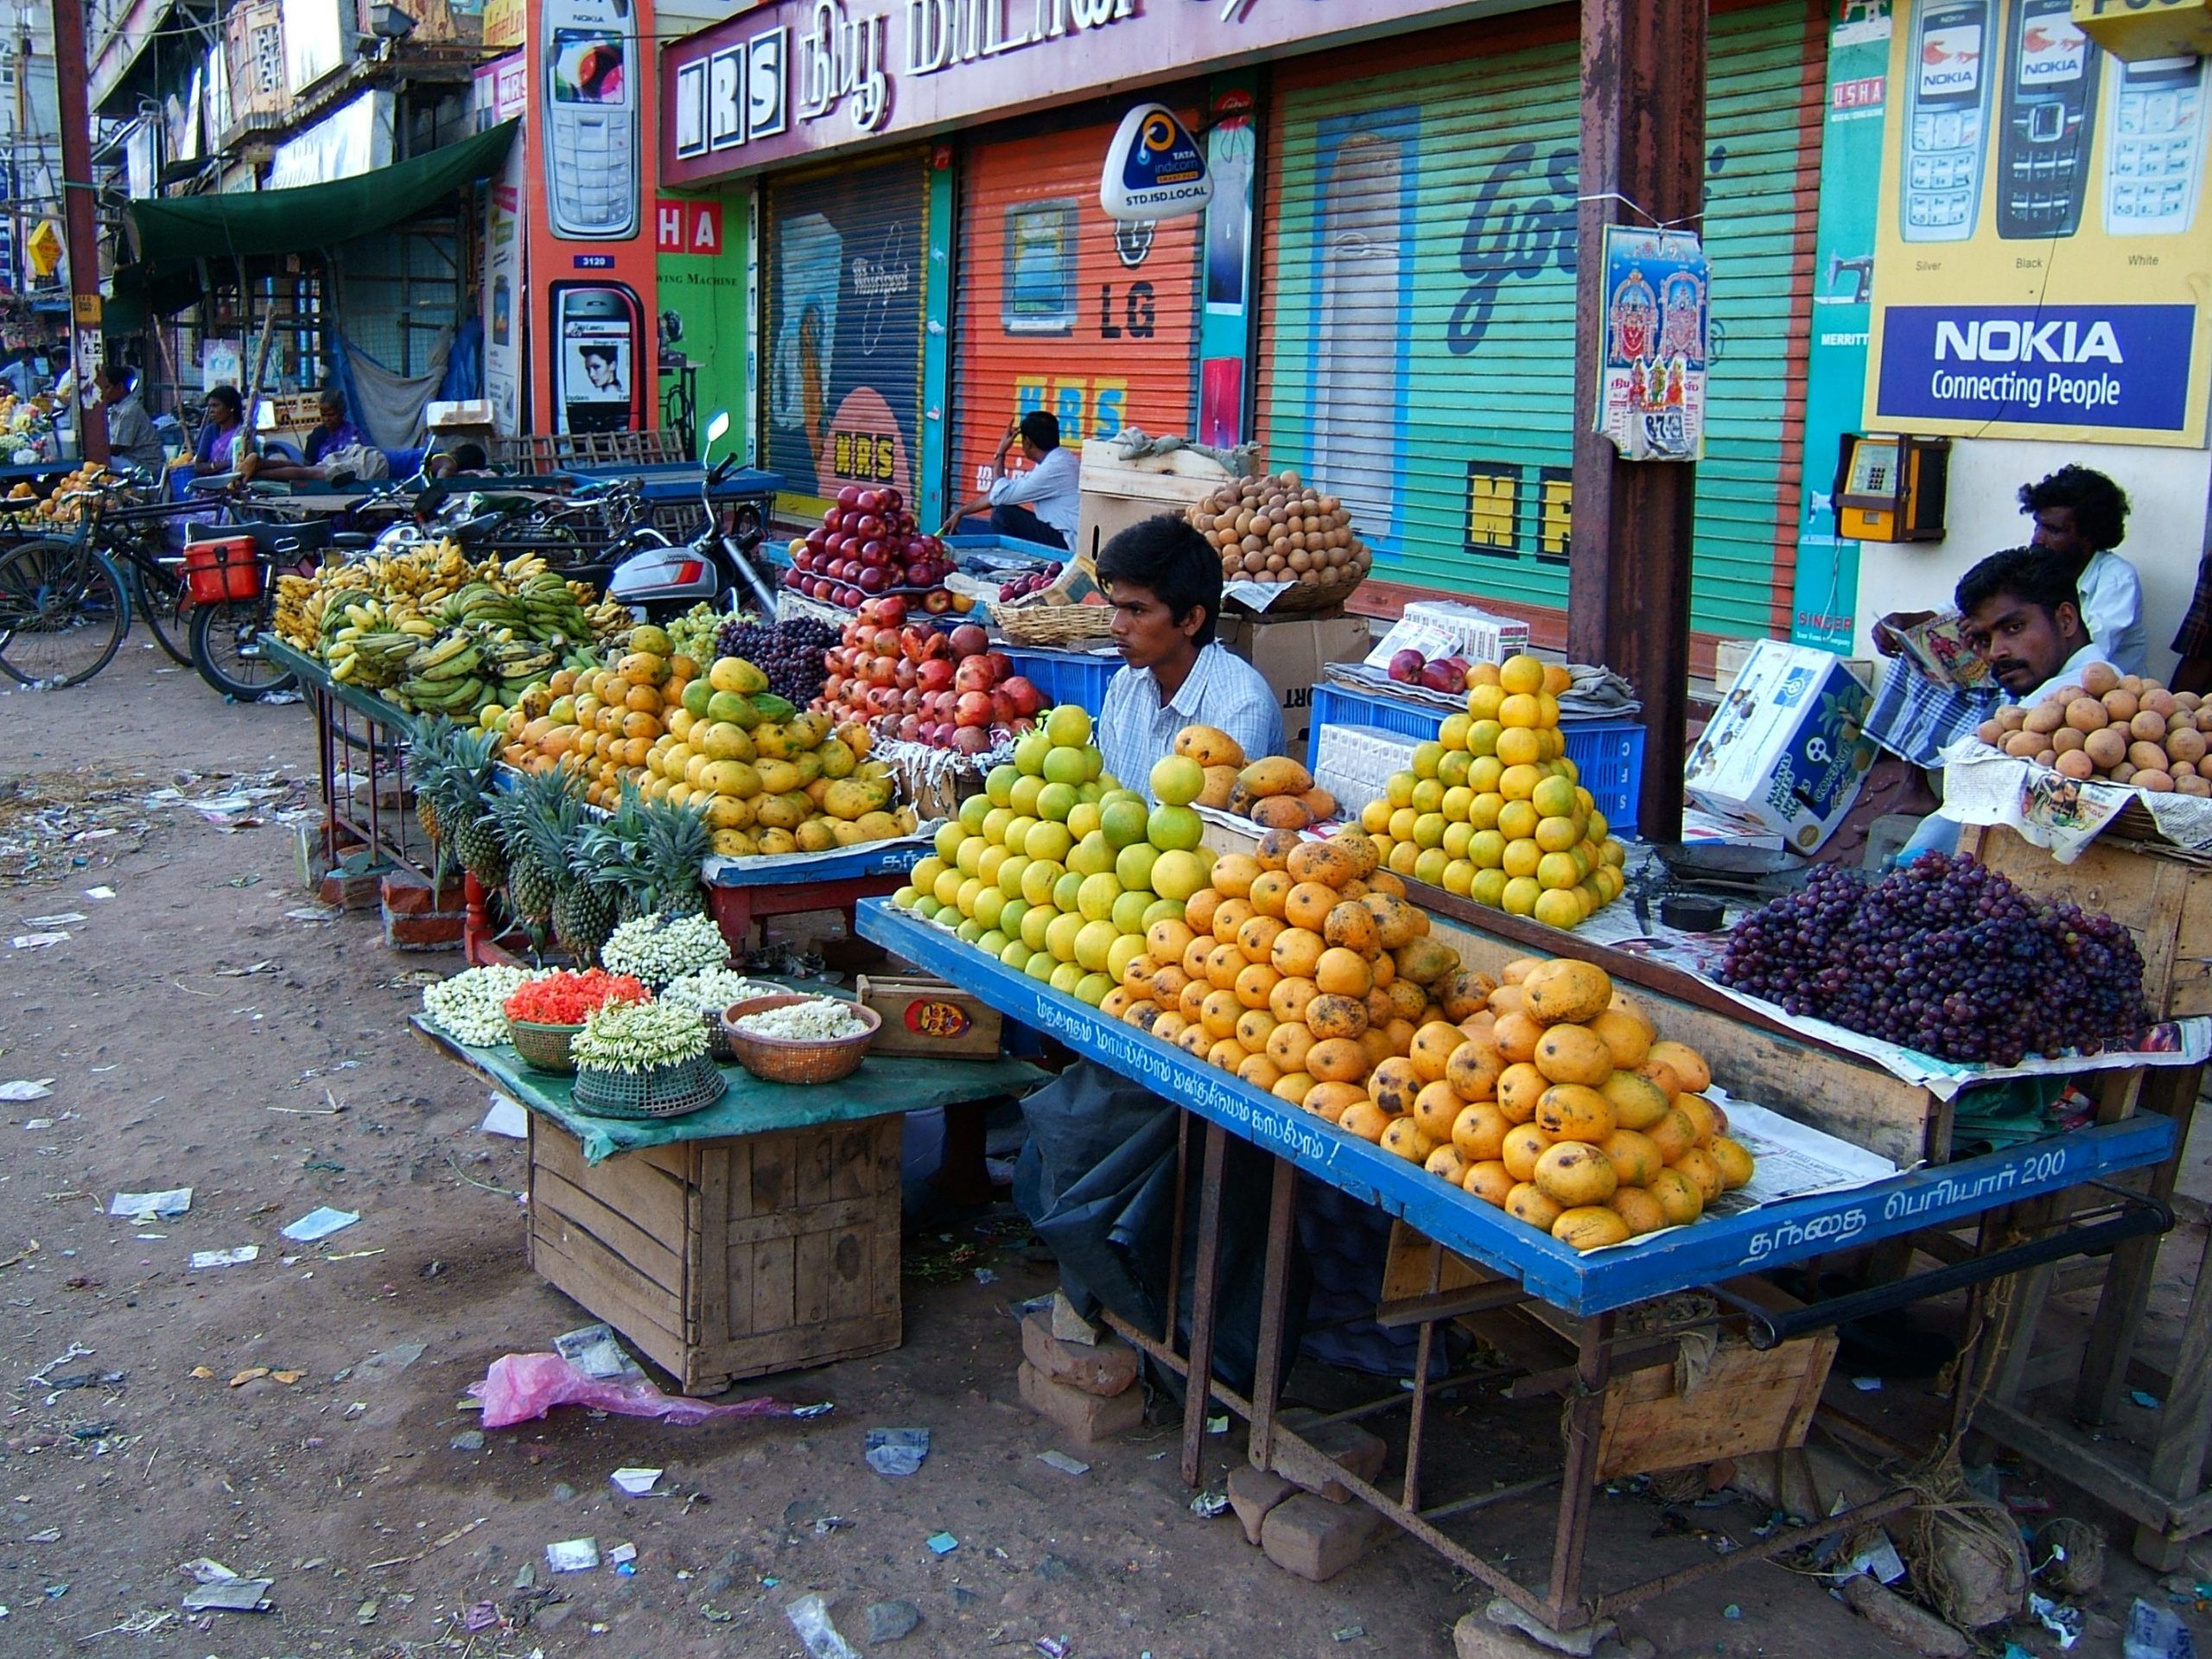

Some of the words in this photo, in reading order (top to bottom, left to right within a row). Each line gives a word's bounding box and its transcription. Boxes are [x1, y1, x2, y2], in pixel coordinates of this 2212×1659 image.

[1924, 71, 1974, 86] NOKIA
[2025, 60, 2078, 75] NOKIA
[1834, 80, 1882, 108] USHA
[1173, 150, 1196, 161] TATA
[1126, 187, 1207, 206] STD.ISD.LOCAL
[658, 208, 715, 248] HA
[582, 257, 606, 266] 3120
[1916, 261, 1942, 271] Silver
[2016, 257, 2043, 269] Black
[2128, 255, 2159, 266] White
[1101, 281, 1155, 339] LG
[1821, 333, 1869, 346] MERRITT
[1935, 321, 2124, 364] NOKIA
[1931, 369, 2043, 409] Connecting
[2047, 372, 2120, 410] People
[1467, 467, 1571, 558] MR
[1798, 611, 1852, 632] SINGER
[1765, 752, 1792, 805] MANZANAS
[1773, 772, 1795, 810] APPLES
[1738, 1208, 1866, 1267] தந்தை
[1884, 1162, 2018, 1220] பெரியார்
[2020, 1148, 2066, 1185] 200
